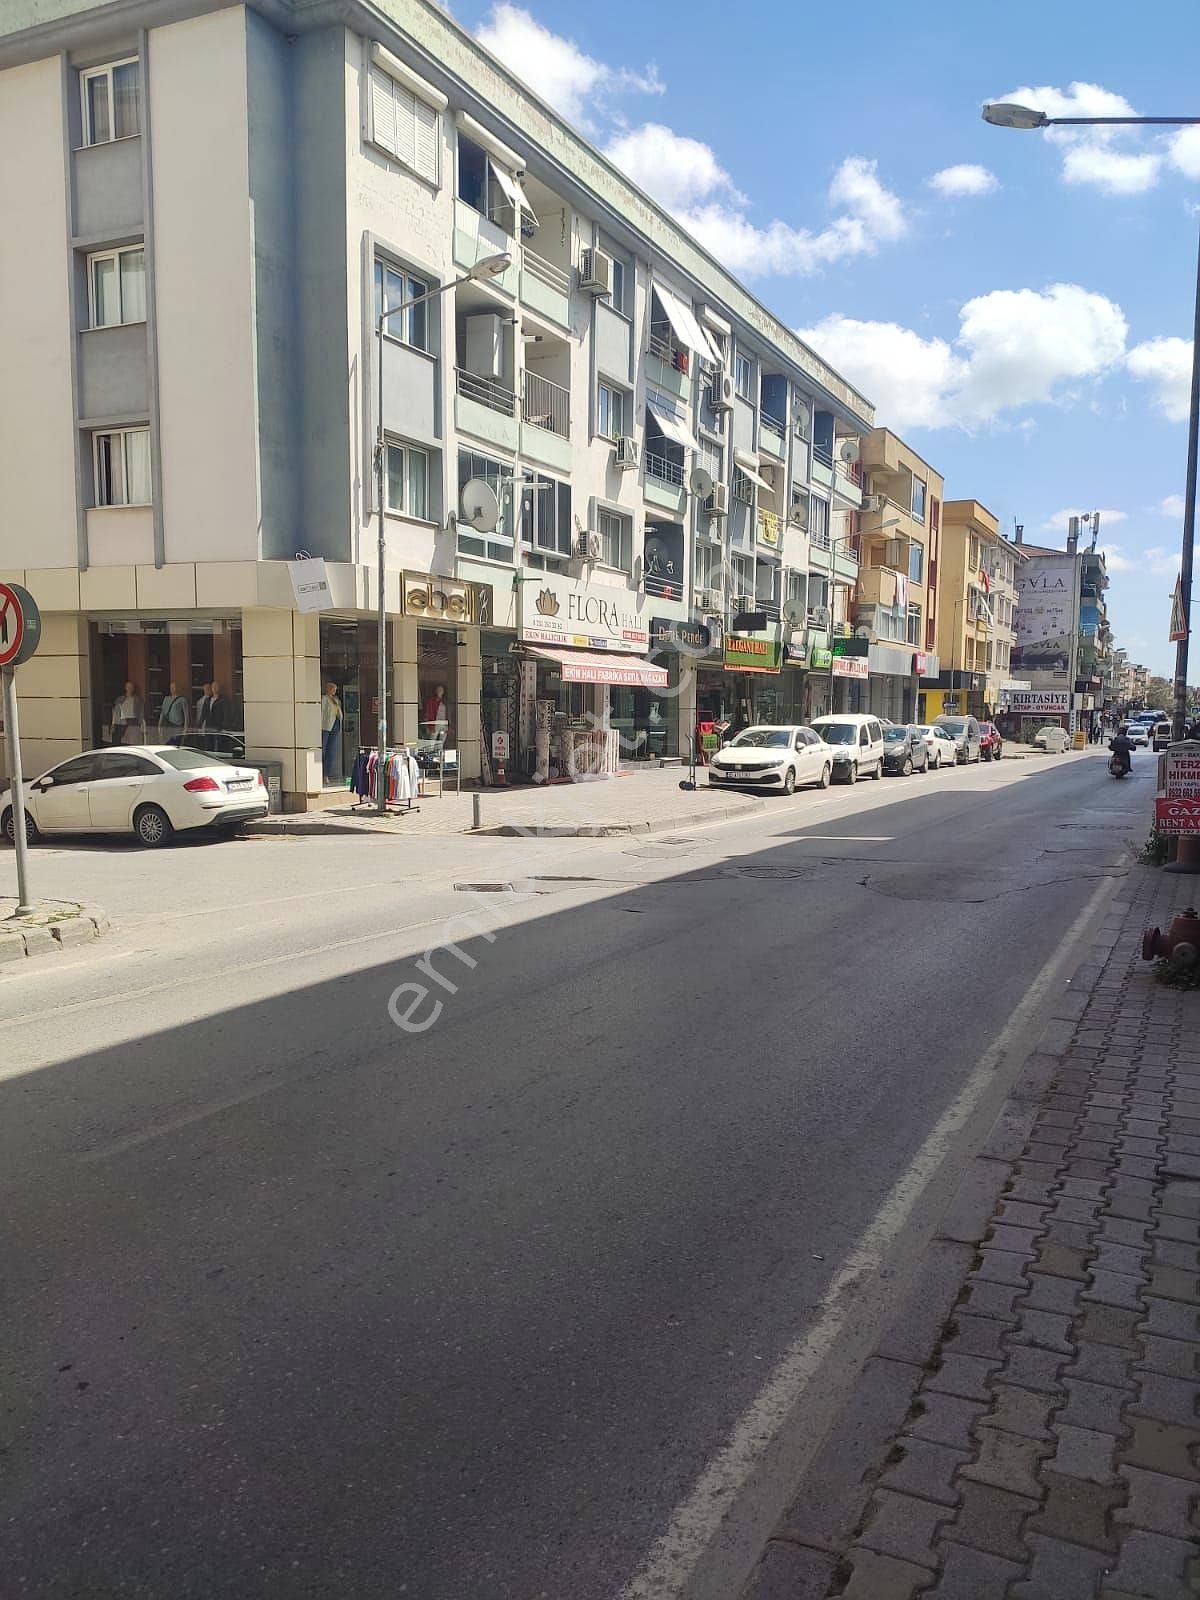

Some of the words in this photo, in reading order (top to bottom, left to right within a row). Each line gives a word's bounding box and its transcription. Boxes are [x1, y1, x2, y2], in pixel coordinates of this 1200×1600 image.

[568, 593, 620, 636] FLORA
[622, 613, 642, 630] HALI
[1013, 692, 1067, 704] KIRTASİYE
[1160, 819, 1185, 828] RENT
